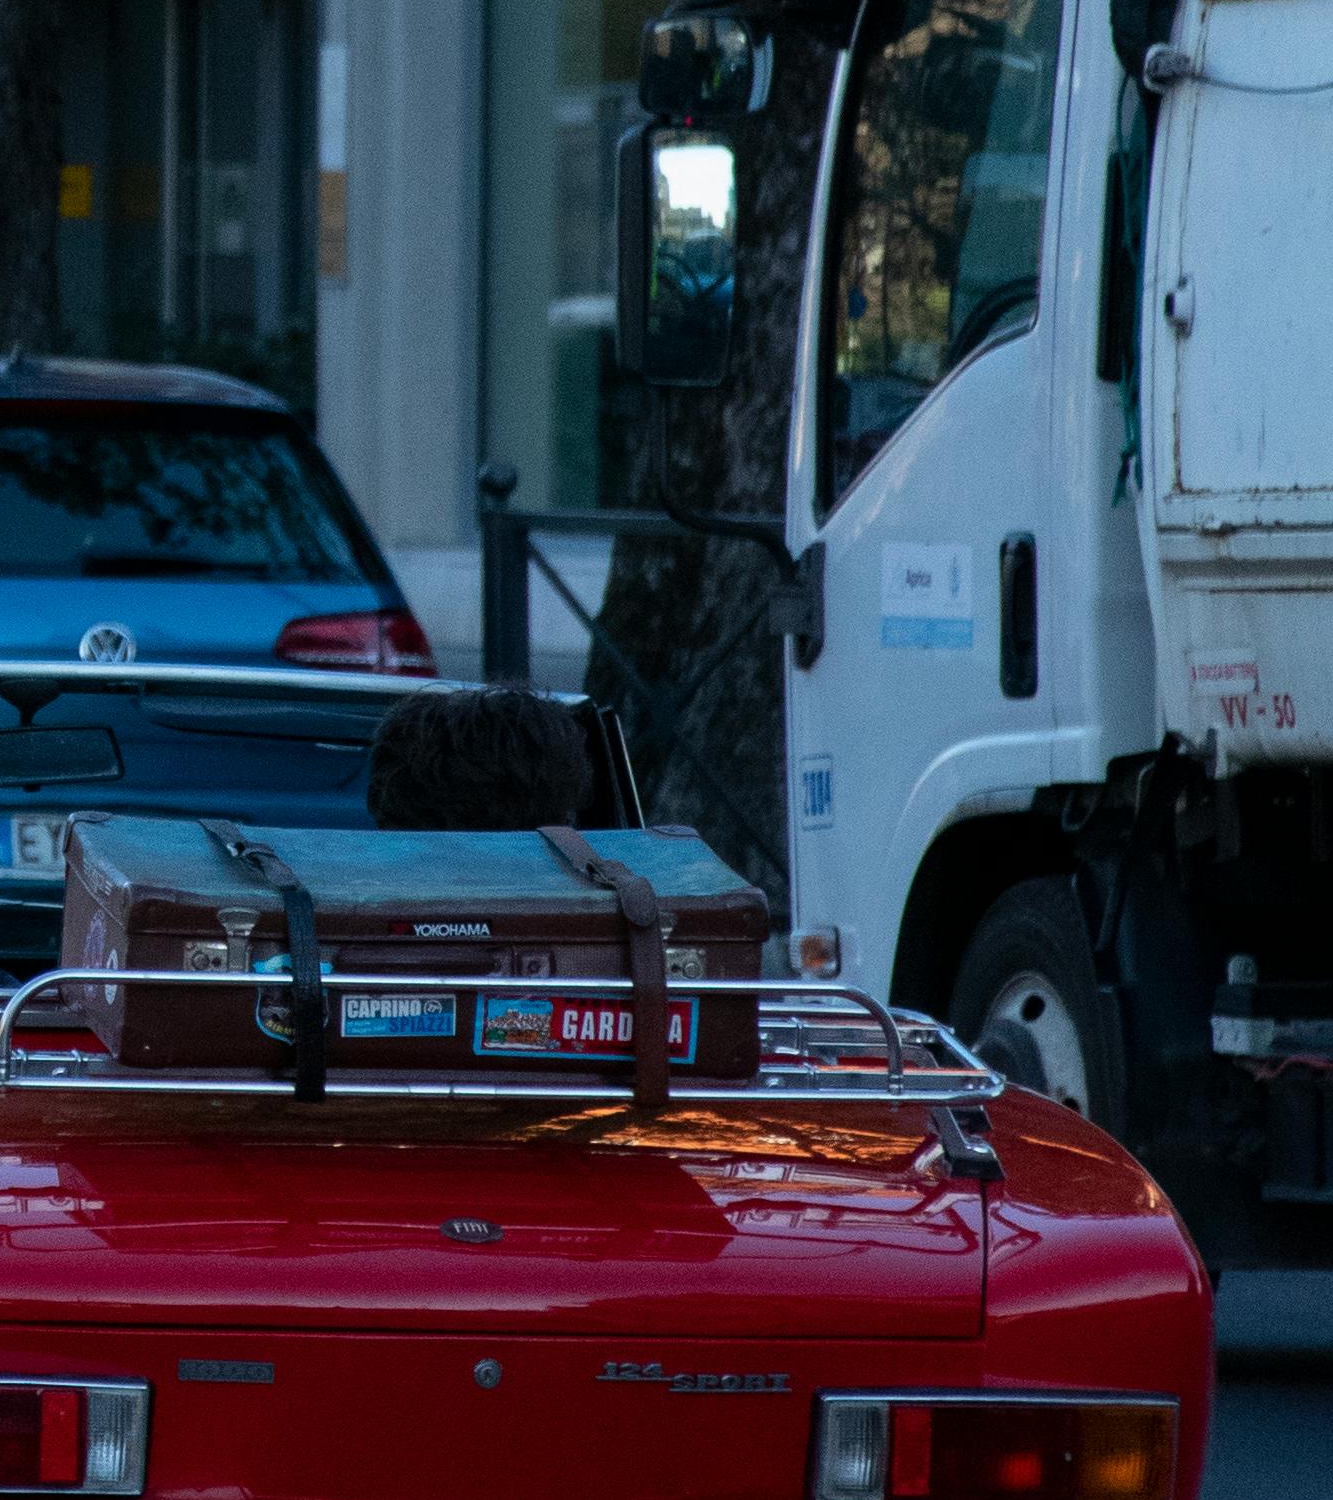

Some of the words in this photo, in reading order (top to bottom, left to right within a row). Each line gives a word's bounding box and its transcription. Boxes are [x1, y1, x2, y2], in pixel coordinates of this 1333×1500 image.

[413, 923, 490, 937] YOKOHAMA
[347, 999, 422, 1018] CAPRINO
[389, 1015, 452, 1034] SPIAZZI
[562, 1009, 683, 1044] GARDA
[603, 1362, 662, 1379] 124
[671, 1373, 791, 1391] SPORT
